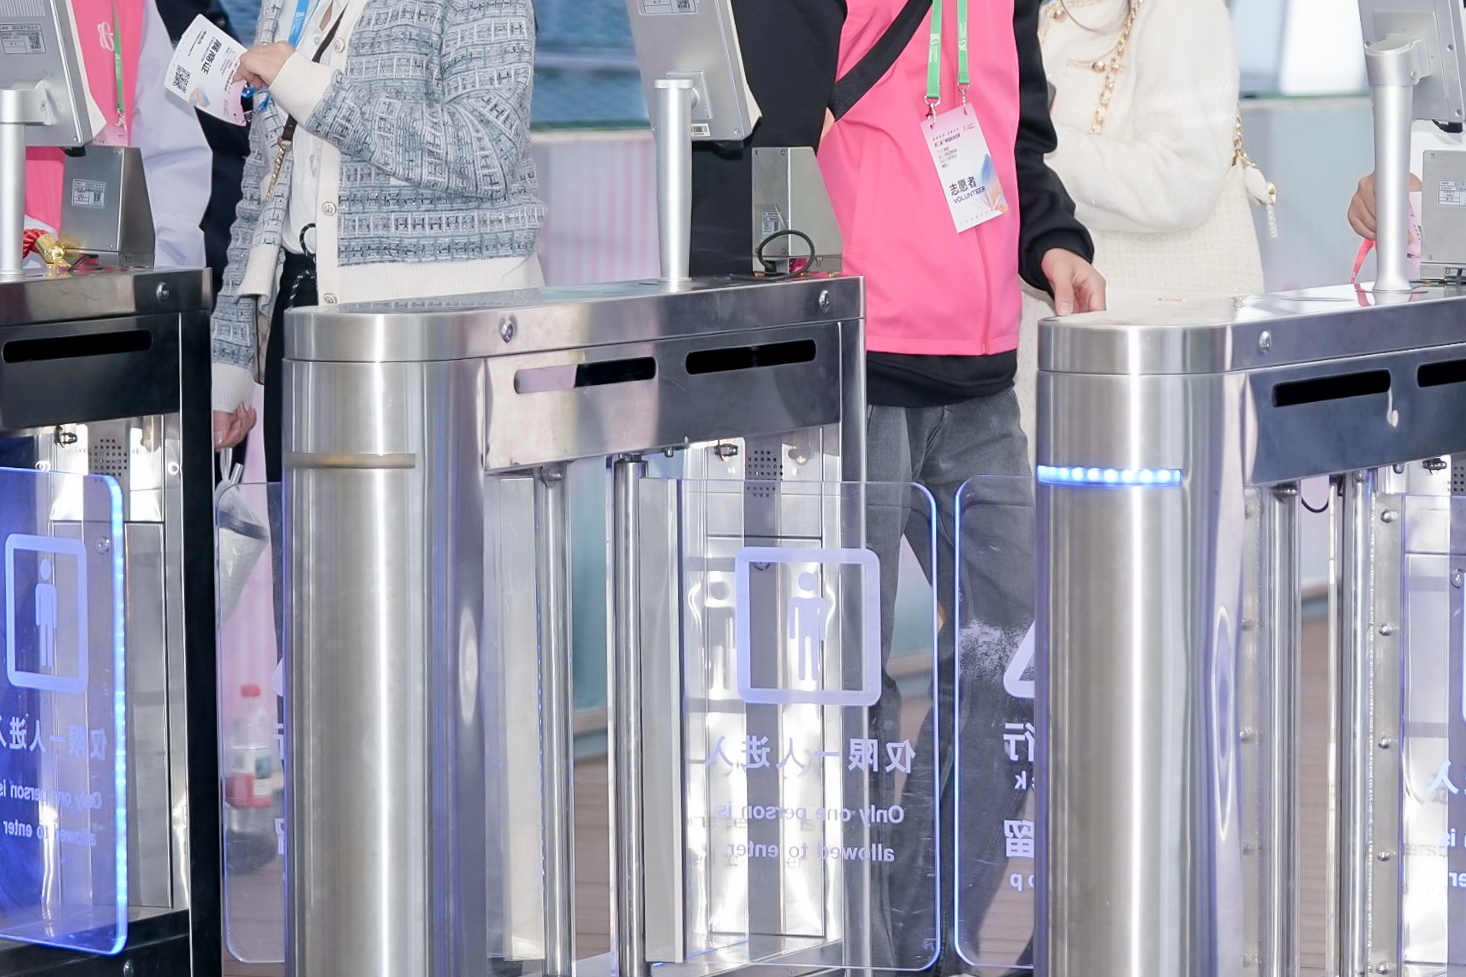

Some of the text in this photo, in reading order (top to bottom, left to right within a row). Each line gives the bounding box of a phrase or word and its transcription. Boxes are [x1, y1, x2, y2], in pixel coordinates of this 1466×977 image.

[949, 176, 977, 197] 志愿者
[953, 185, 987, 204] VOLUNTEER
